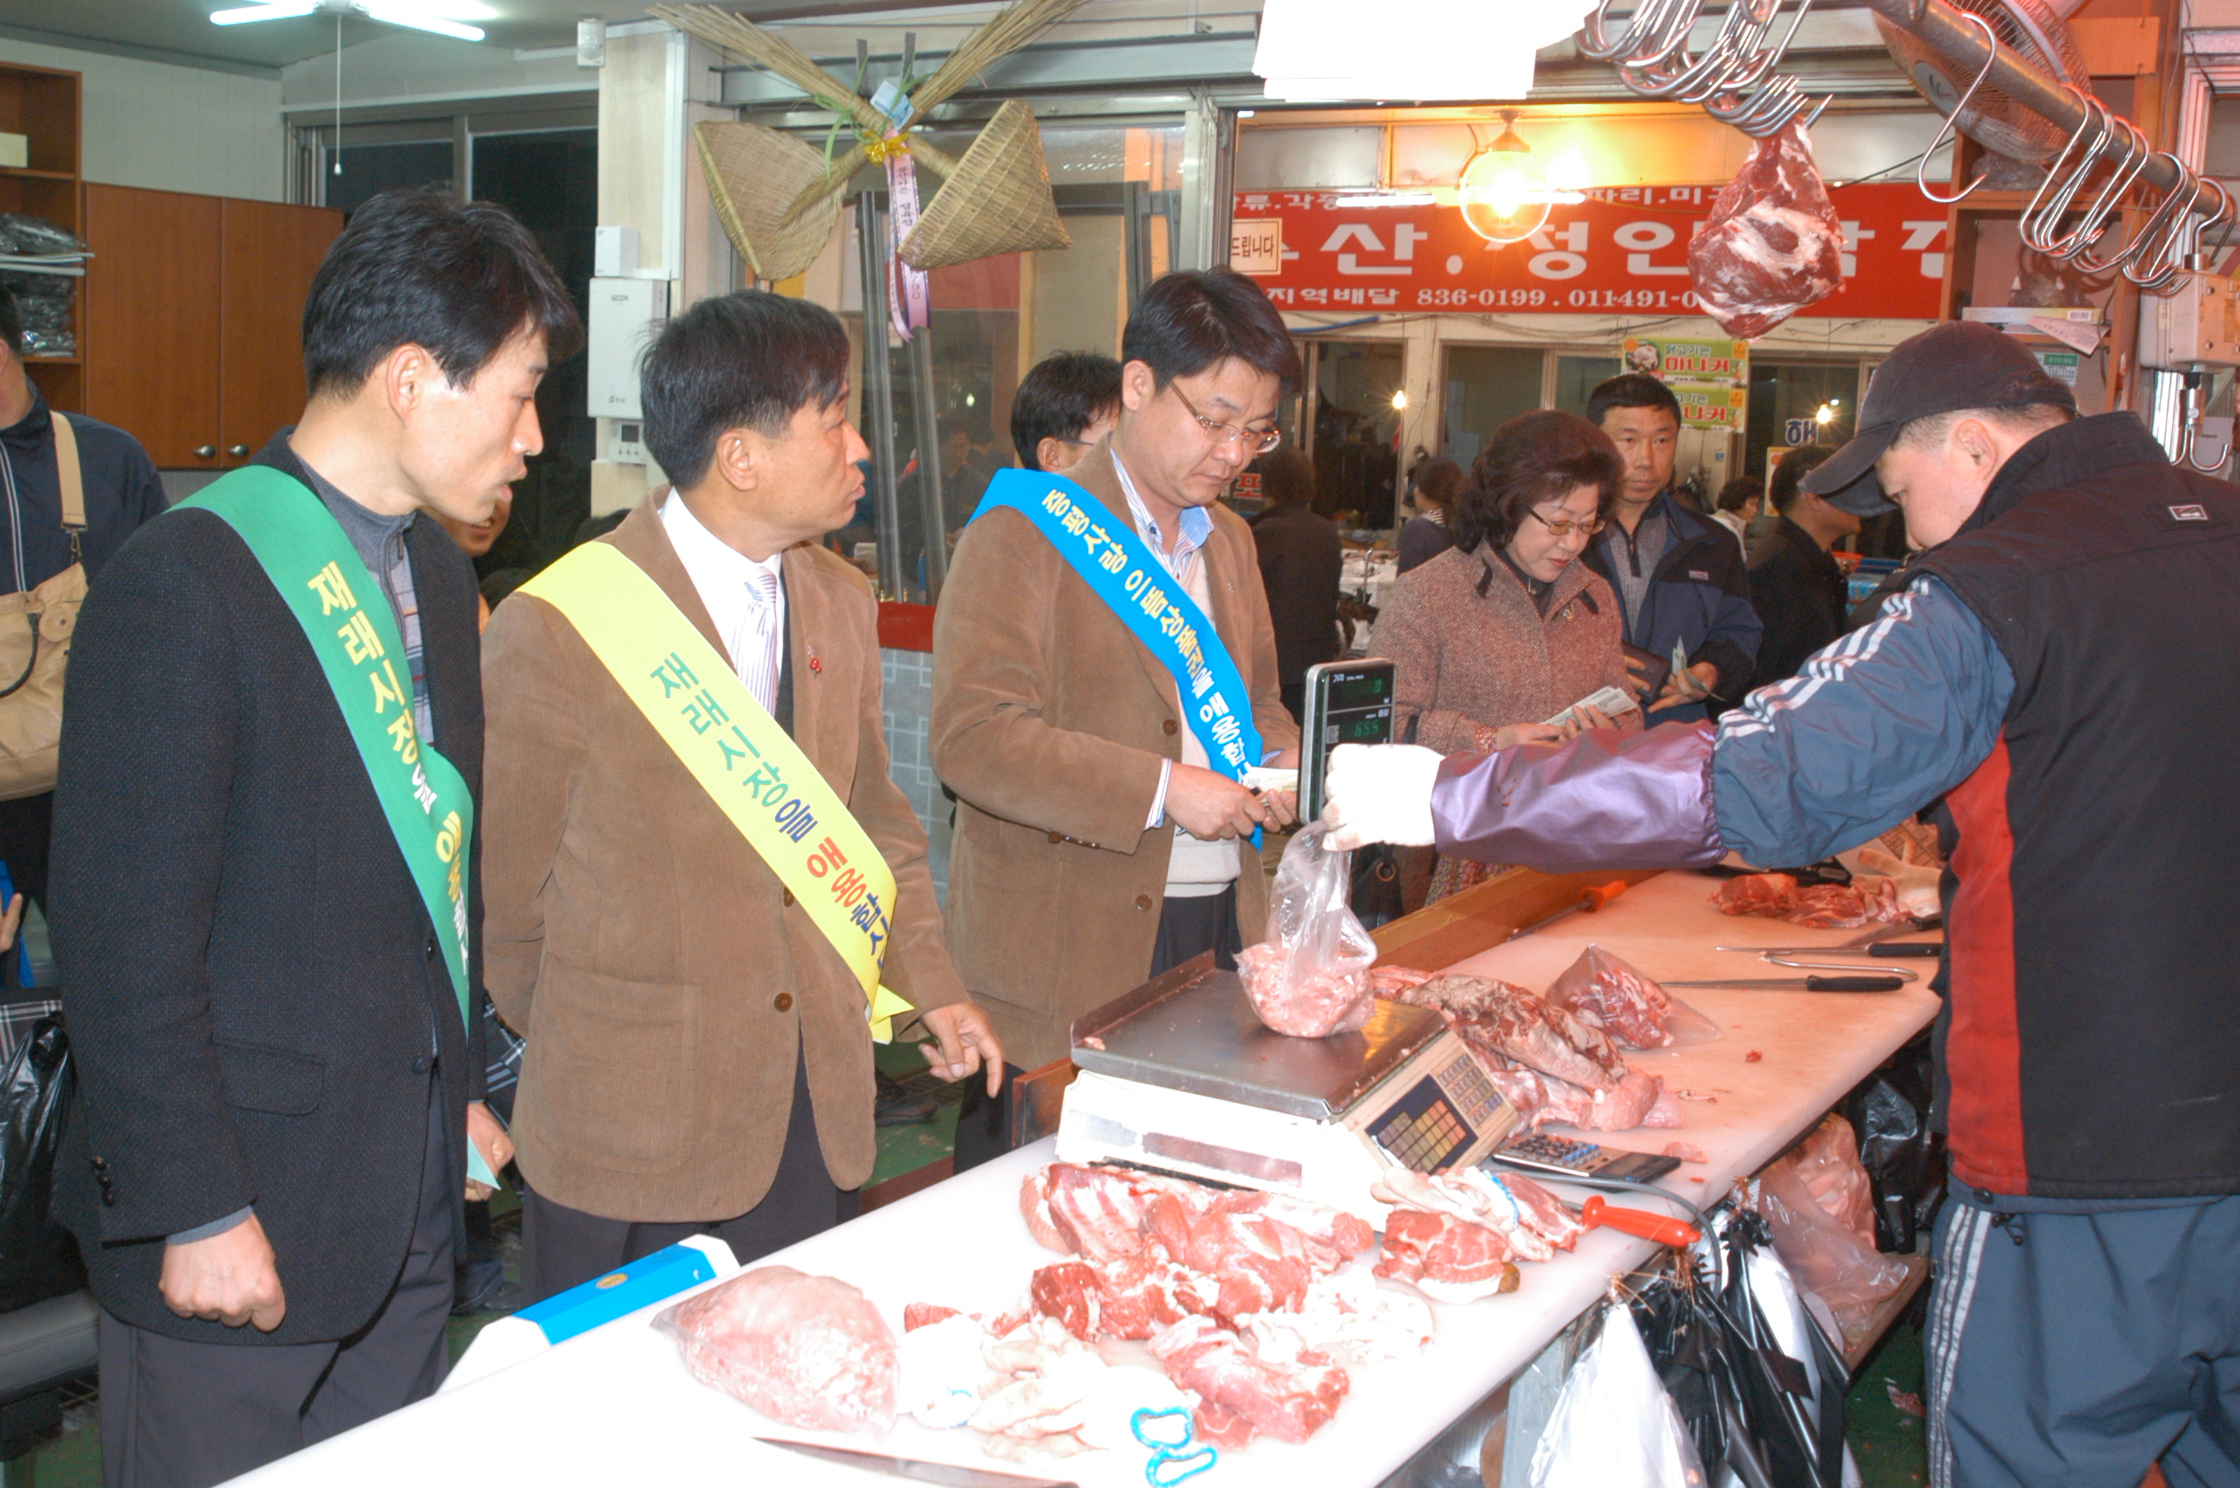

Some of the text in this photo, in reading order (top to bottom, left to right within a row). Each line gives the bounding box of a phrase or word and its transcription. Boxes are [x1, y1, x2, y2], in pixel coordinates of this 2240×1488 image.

[1416, 288, 1546, 306] 836-0199
[1665, 356, 1731, 374] 마니커
[307, 560, 438, 815] 재래시장을
[1041, 488, 1128, 574] 증평사랑
[1124, 569, 1215, 699] 으뜸상품권을
[650, 651, 890, 969] 재래시장을 애용합시
